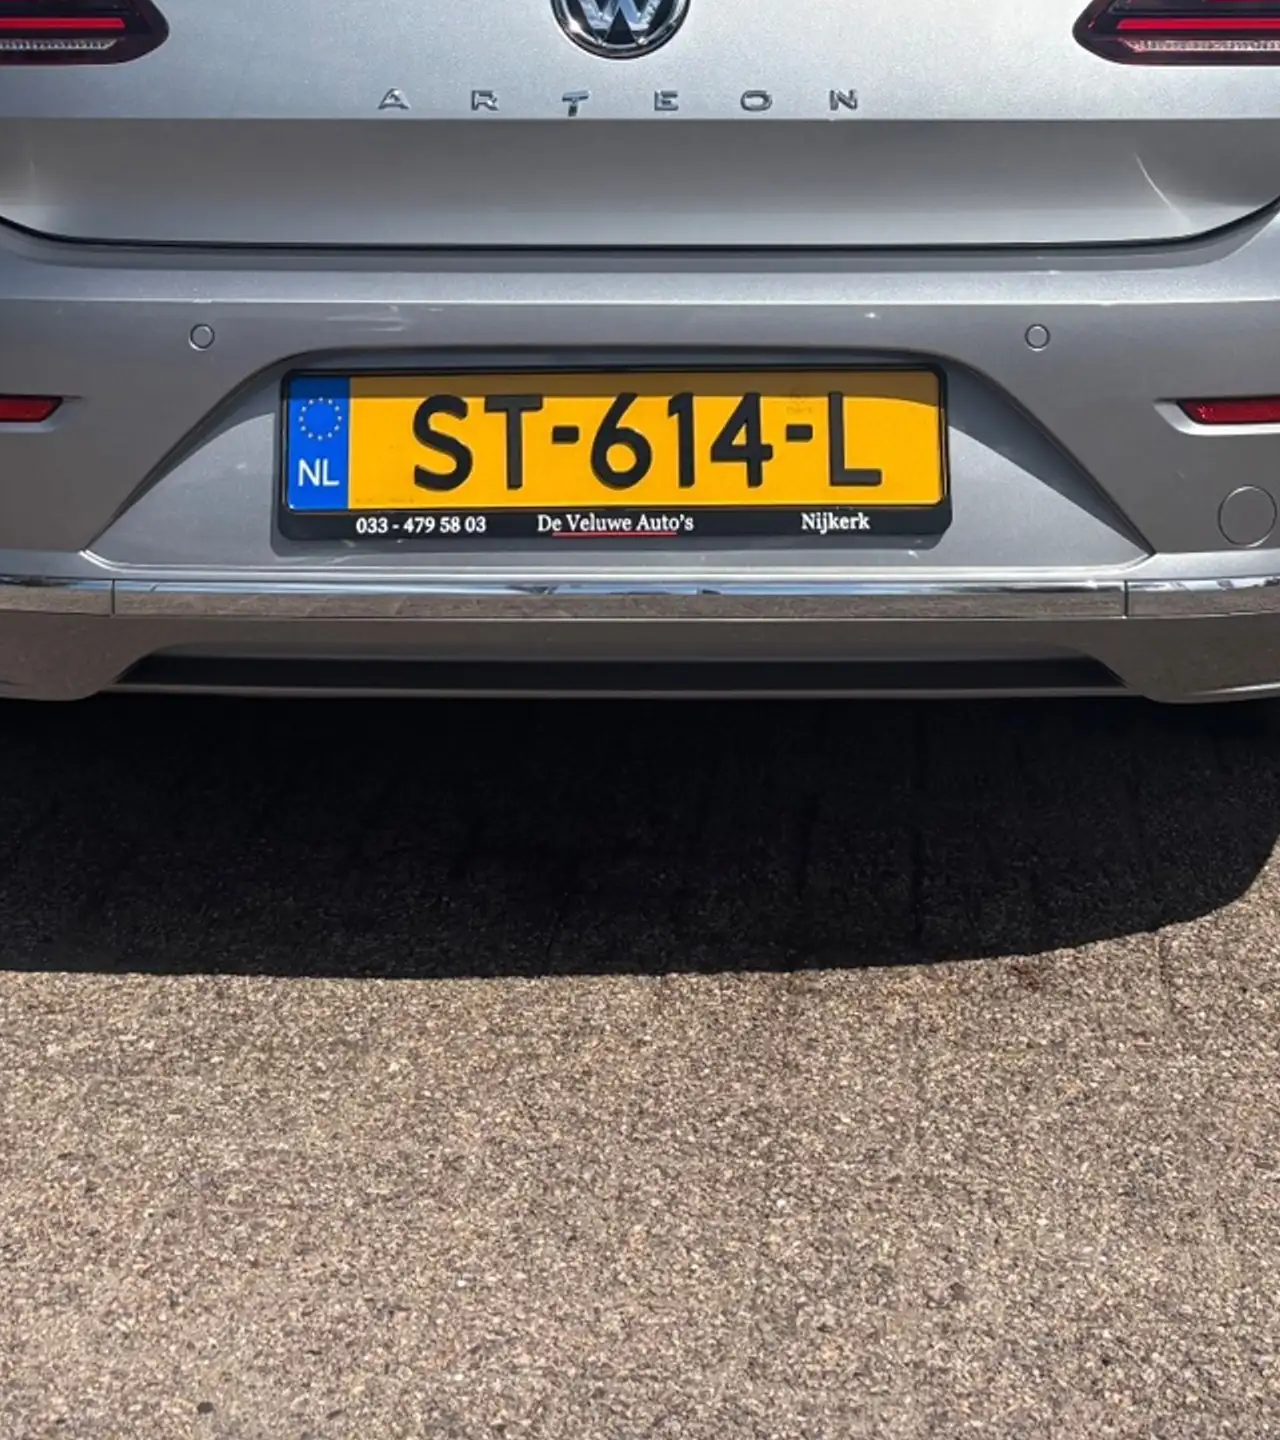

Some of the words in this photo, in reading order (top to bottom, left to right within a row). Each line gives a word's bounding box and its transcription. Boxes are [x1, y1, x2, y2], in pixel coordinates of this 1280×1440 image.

[377, 87, 859, 118] ARTEON
[412, 391, 883, 492] ST-614-L
[297, 457, 340, 488] NL
[355, 516, 389, 534] 033
[403, 516, 436, 534] 479
[439, 515, 462, 534] 58
[464, 515, 487, 533] 03
[537, 514, 562, 532] De
[565, 512, 632, 532] Veluwe
[635, 513, 695, 532] Auto's
[801, 511, 871, 535] Nijkerk
